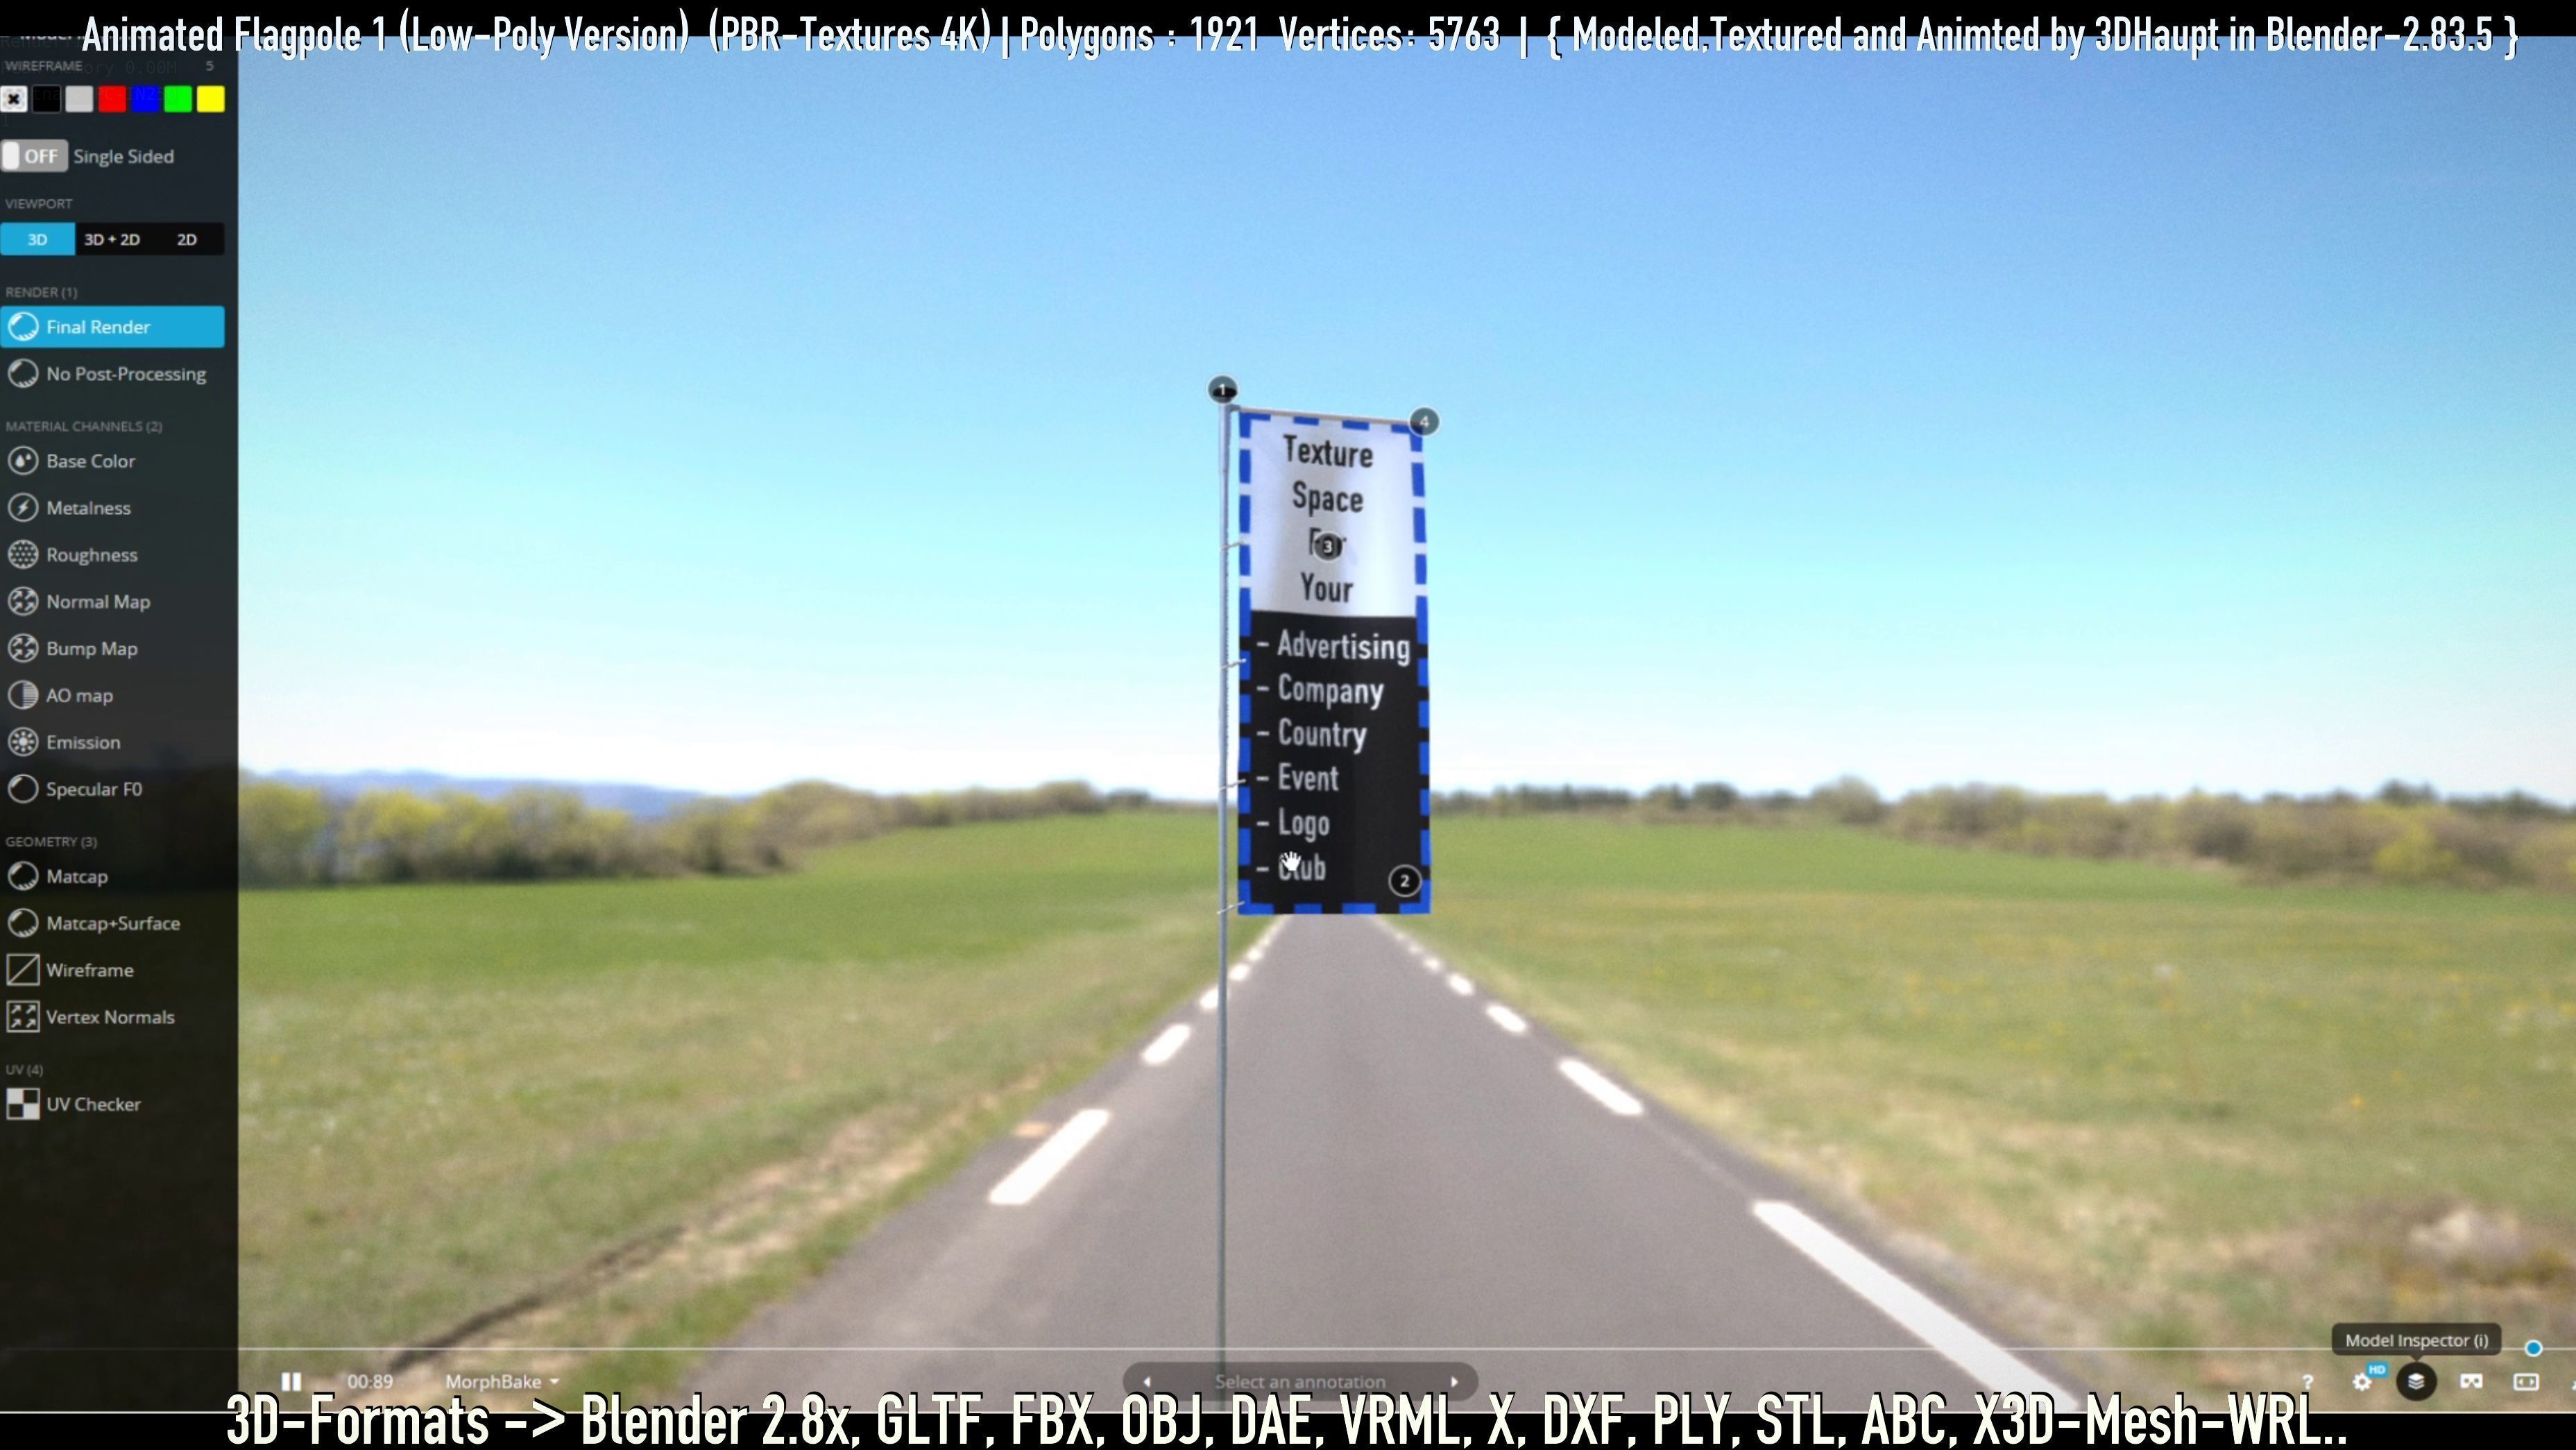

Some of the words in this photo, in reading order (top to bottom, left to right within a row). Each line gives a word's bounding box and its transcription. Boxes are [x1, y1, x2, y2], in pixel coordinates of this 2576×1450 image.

[5, 60, 83, 71] WIREFRAME
[206, 61, 214, 71] 5
[25, 149, 58, 164] OFF
[74, 148, 124, 168] Single
[128, 148, 174, 164] Sided
[5, 198, 74, 210] VIEWPORT
[28, 233, 48, 246] 3D
[85, 233, 105, 246] 3D
[120, 233, 140, 246] 2D
[177, 233, 197, 246] 2D
[6, 287, 58, 298] RENDER
[61, 287, 78, 300] (1)
[47, 320, 86, 334] Final
[92, 320, 151, 334] Render
[47, 367, 71, 382] No
[76, 366, 207, 385] Post-Processing
[6, 420, 69, 432] MATERIAL
[72, 420, 143, 432] CHANNELS
[146, 421, 163, 434] (2)
[1420, 416, 1430, 428] 4
[1283, 434, 1374, 468] Texture
[47, 454, 87, 468] Base
[91, 454, 137, 468] Color
[1293, 479, 1364, 517] Space
[47, 500, 131, 515] Metalness
[47, 547, 138, 566] Roughness
[1301, 572, 1354, 603] Your
[47, 594, 109, 609] Normal
[114, 594, 151, 613] Map
[47, 641, 96, 659] Bump
[102, 641, 138, 659] Map
[1277, 628, 1410, 667] Advertising
[46, 688, 71, 703] AO
[76, 691, 114, 706] map
[1277, 673, 1385, 710] Company
[47, 735, 121, 750] Emission
[1277, 717, 1367, 754] Country
[1277, 762, 1340, 792] Event
[46, 781, 119, 800] Specular
[1277, 807, 1331, 843] Logo
[6, 836, 78, 847] GEOMETRY
[80, 836, 97, 849] (3)
[47, 869, 108, 887] Matcap
[1400, 875, 1410, 887] 2
[47, 916, 180, 934] Matcap+Surface
[46, 963, 134, 978] Wireframe
[46, 1009, 99, 1025] Vertex
[105, 1009, 175, 1025] Normals
[6, 1064, 24, 1075] UV
[26, 1064, 44, 1078] (4)
[47, 1097, 71, 1111] UV
[74, 1097, 142, 1111] Checker
[2346, 1334, 2394, 1347] Model
[2398, 1334, 2471, 1351] Inspector
[2474, 1334, 2489, 1349] (i)
[2369, 1365, 2386, 1374] HD
[347, 1374, 393, 1389] 00:89
[445, 1374, 542, 1392] MorphBake
[1216, 1374, 1265, 1389] Select
[1269, 1378, 1290, 1389] an
[1295, 1374, 1386, 1389] annotation
